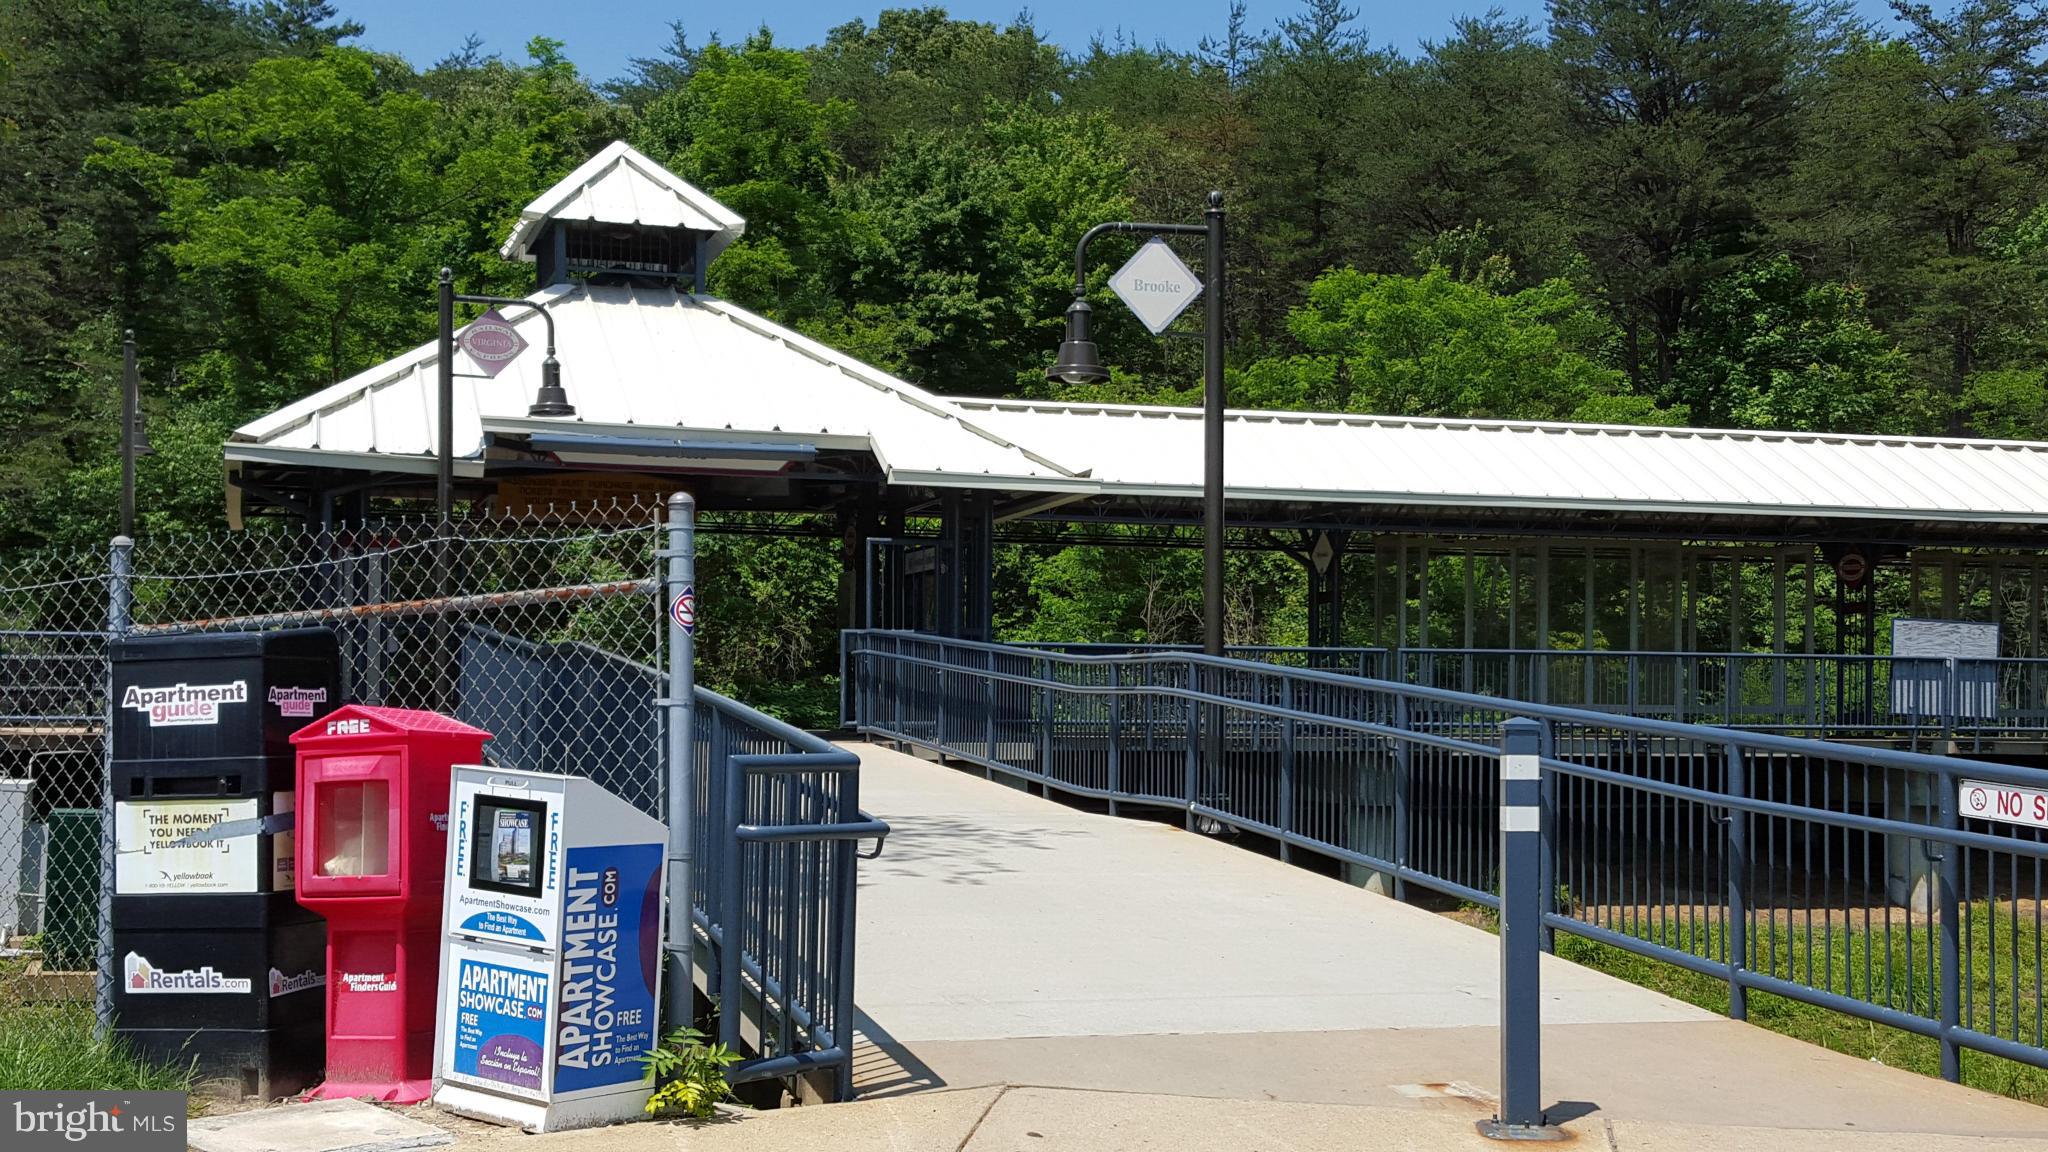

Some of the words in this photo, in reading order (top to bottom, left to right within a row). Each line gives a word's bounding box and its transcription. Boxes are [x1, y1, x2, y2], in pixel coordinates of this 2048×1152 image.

[1133, 279, 1181, 293] Brooke
[471, 337, 511, 348] VIRGINIA
[125, 683, 244, 708] Apartment
[270, 688, 325, 702] Apartment
[152, 700, 212, 723] guide
[282, 700, 311, 713] guide
[327, 719, 370, 735] FREE
[1997, 790, 2023, 817] NO
[2033, 795, 2048, 821] S
[149, 815, 169, 825] THE
[173, 814, 223, 825] MOMENT
[430, 812, 449, 824] Apart
[499, 818, 529, 828] SHOWCASE
[150, 828, 173, 837] YOU
[457, 801, 468, 877] FREE
[216, 840, 224, 848] IT
[546, 812, 559, 890] FREE
[173, 872, 213, 881] yellowbook
[460, 894, 550, 916] ApartmentShowcase.com
[487, 912, 495, 921] The
[496, 914, 507, 923] Best
[485, 922, 494, 931] Find
[502, 925, 527, 935] Apartment
[558, 867, 599, 1069] APARTMENT
[150, 970, 249, 989] Rentals.com
[343, 973, 384, 984] Apartment
[461, 964, 547, 1003] APARTMENT
[350, 981, 378, 991] Finders
[461, 1012, 478, 1026] FREE
[616, 1009, 642, 1027] FREE
[616, 1034, 625, 1043] The
[627, 1033, 637, 1042] Best
[638, 1032, 649, 1041] Way
[622, 1043, 632, 1053] Find
